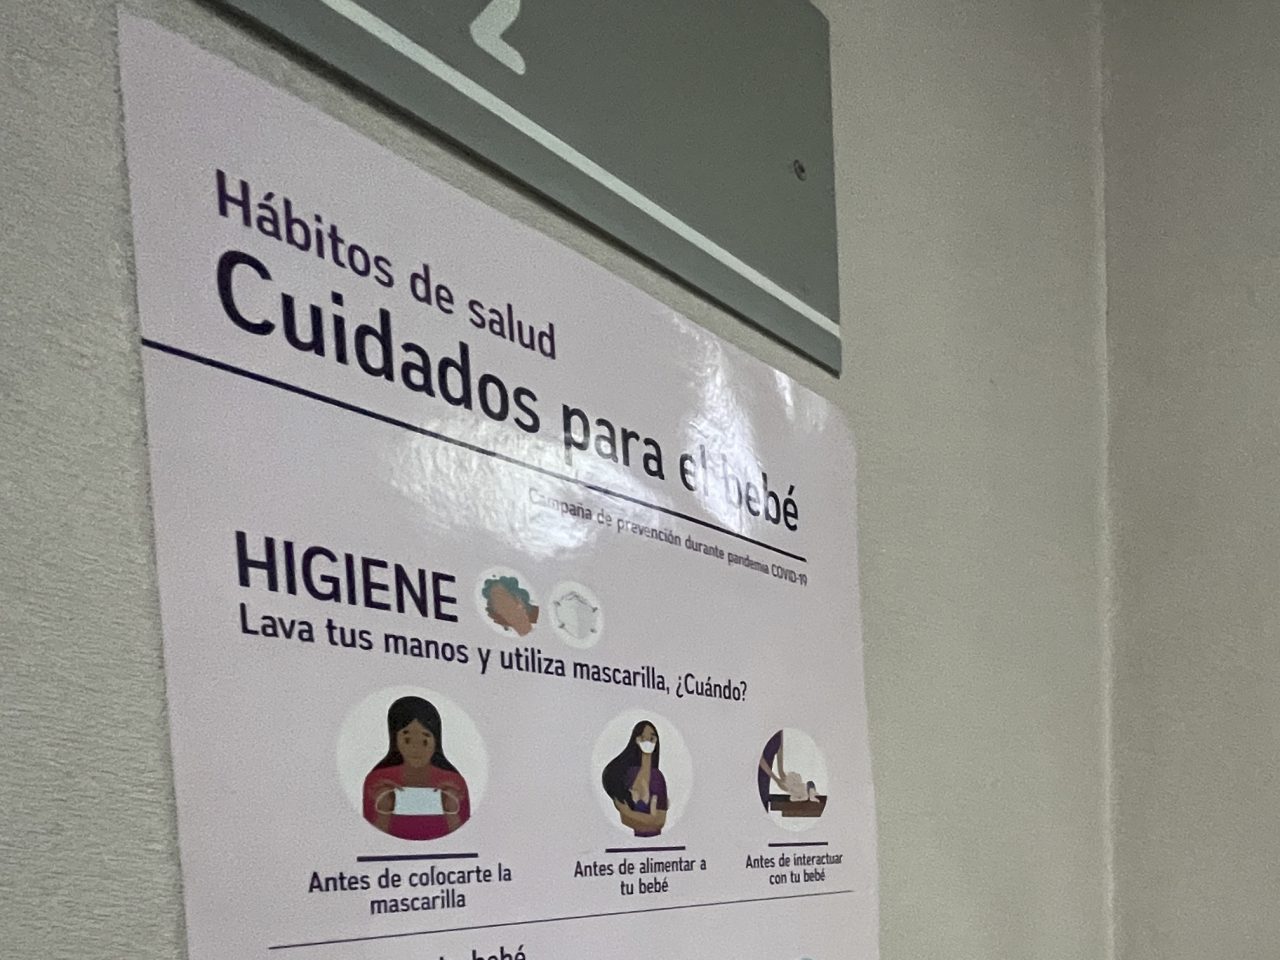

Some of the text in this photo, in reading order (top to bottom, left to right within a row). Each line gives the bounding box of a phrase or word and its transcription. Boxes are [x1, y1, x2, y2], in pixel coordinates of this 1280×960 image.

[216, 168, 556, 360] Hábitos de salud
[216, 249, 799, 531] Cuidados para el bebé
[529, 487, 807, 586] Cmpaña de prevención durante pandemia COVID-19
[235, 530, 459, 623] HIGIENE
[240, 602, 747, 701] Lava tus manos y utiliza mascarilla, ¿Cuándo?
[574, 857, 707, 878] Antes de alimentar a
[745, 853, 843, 869] Antes de interactuar
[769, 868, 826, 885] con tu bebé
[308, 862, 512, 893] Antes de colocarte la
[620, 877, 669, 896] tu bebé
[370, 888, 466, 915] mascarilla
